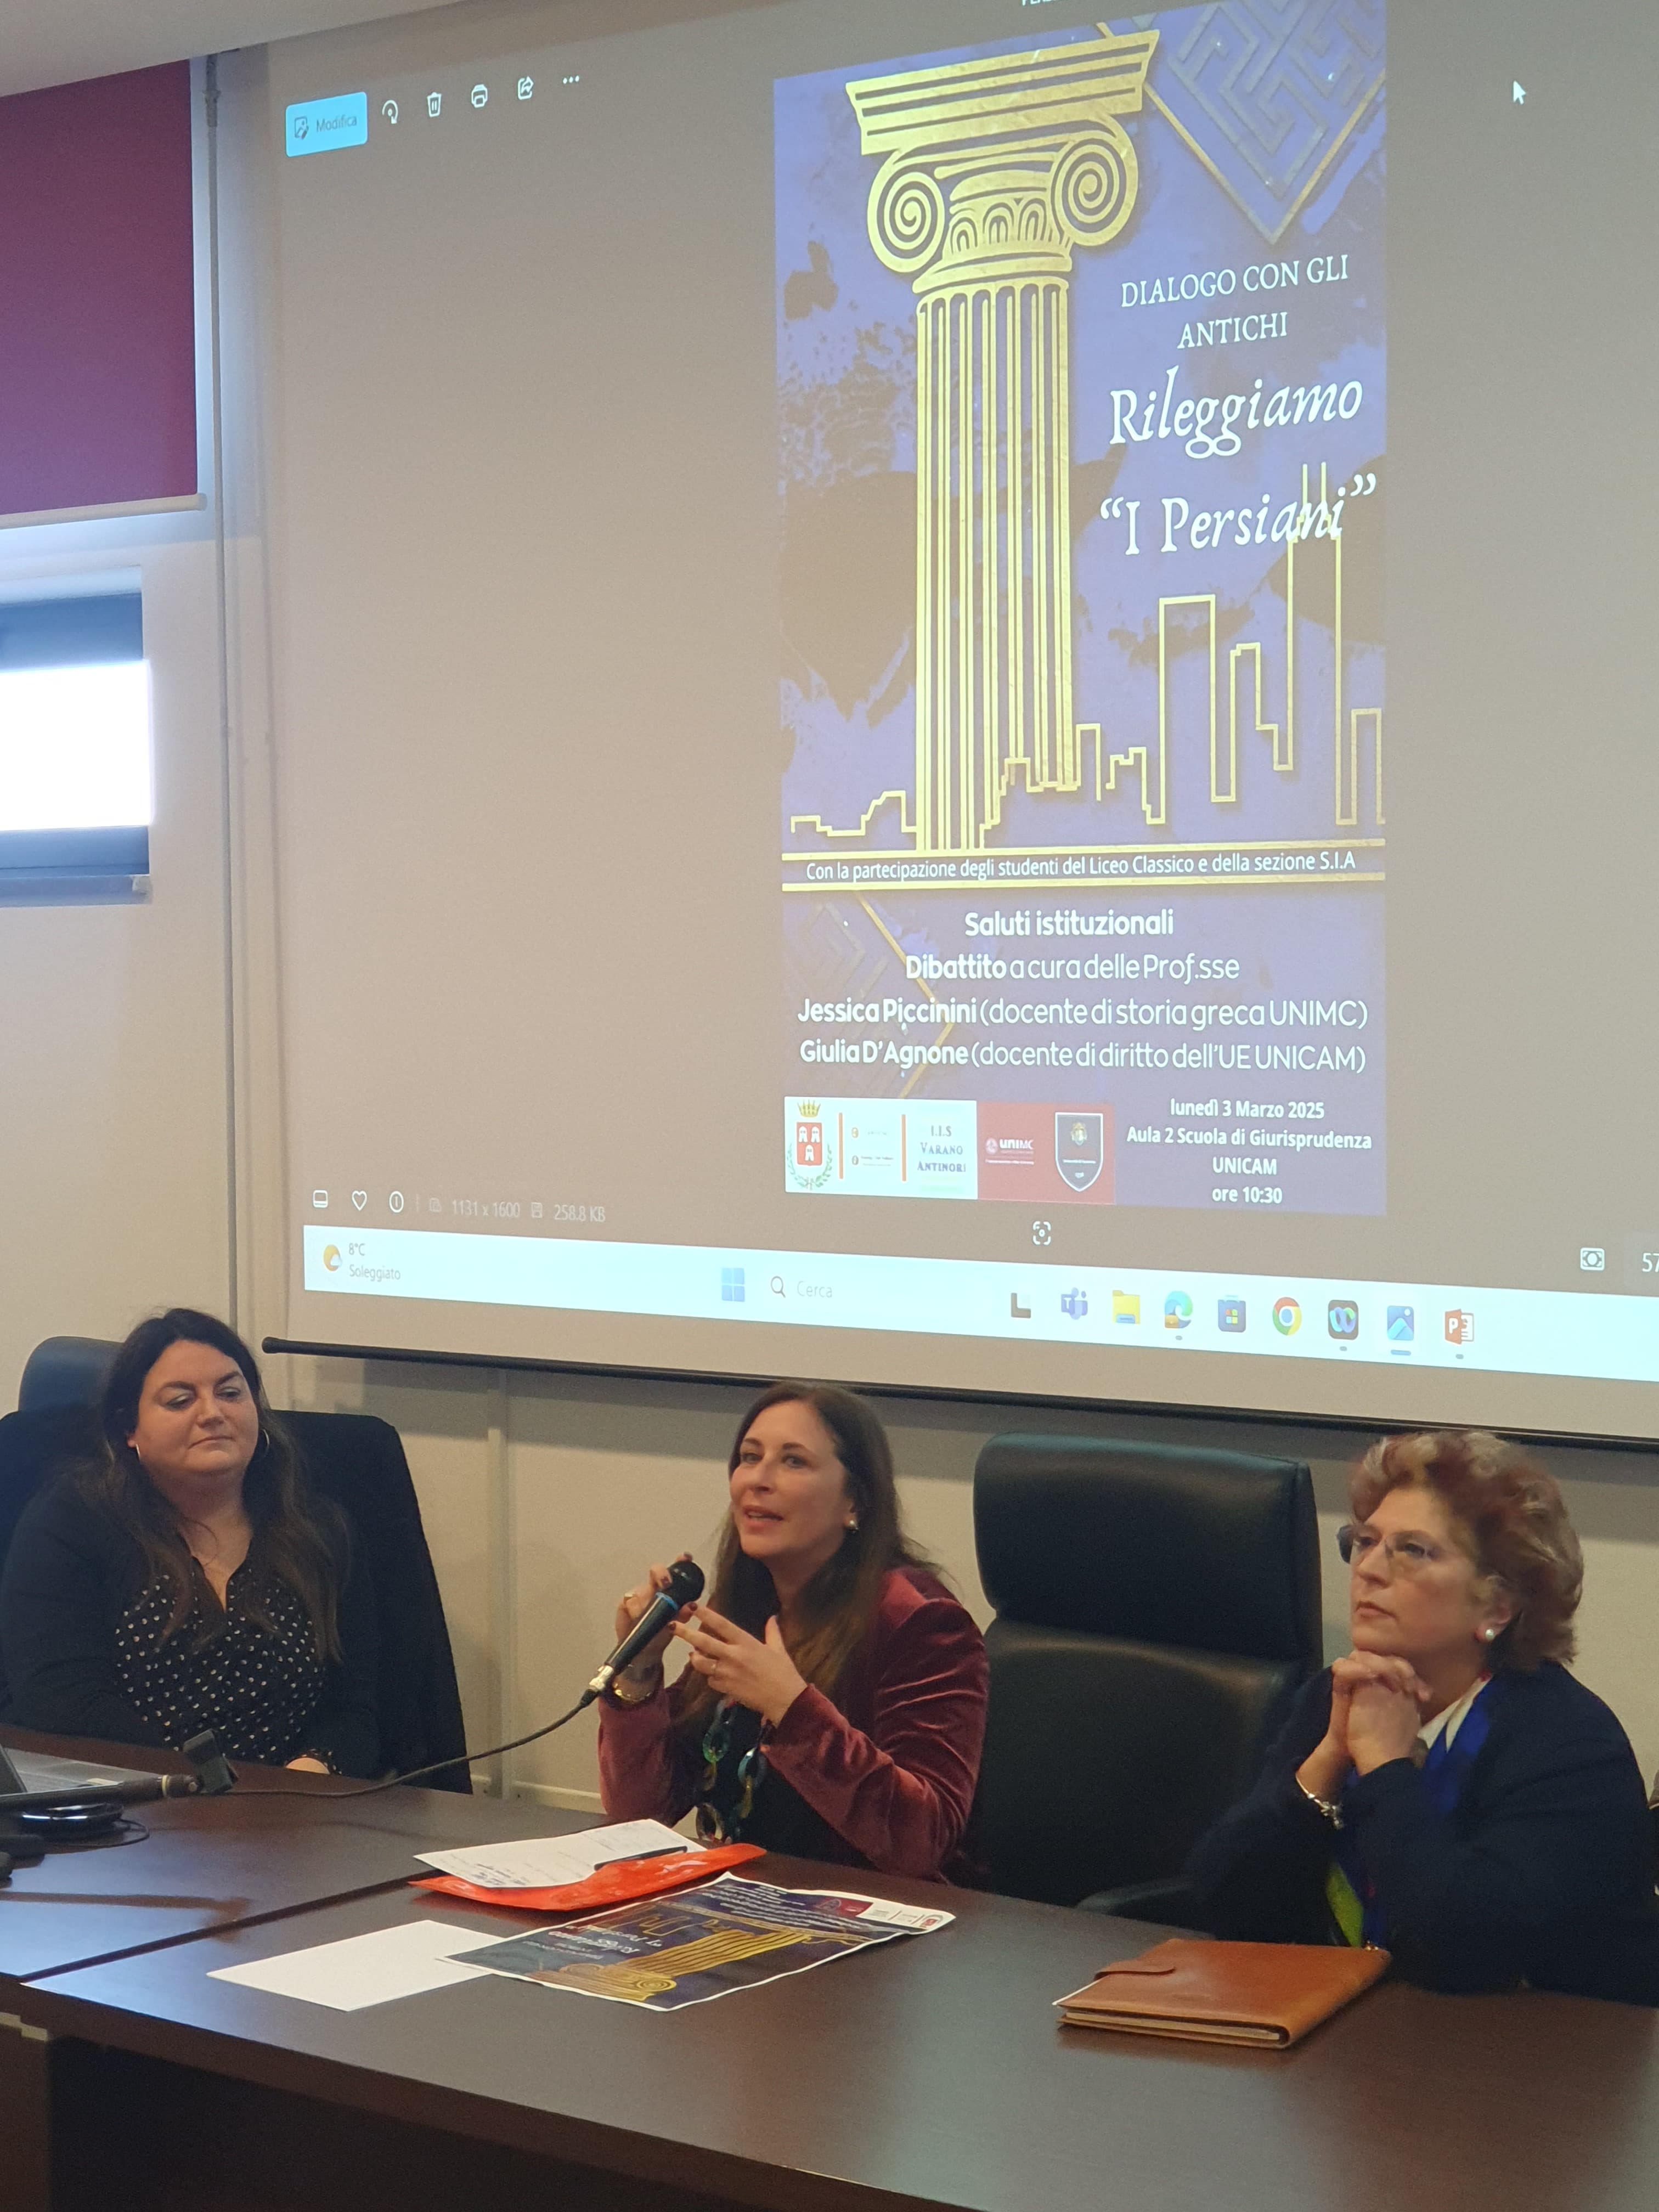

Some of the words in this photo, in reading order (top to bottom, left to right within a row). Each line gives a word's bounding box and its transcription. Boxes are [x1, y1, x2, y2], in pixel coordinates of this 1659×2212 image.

[317, 114, 357, 132] Modifica
[1121, 269, 1236, 307] DIALOGO
[1243, 261, 1300, 291] CON
[1307, 255, 1348, 283] GLI
[1177, 312, 1288, 349] ANTICHI
[1109, 365, 1363, 459] Rileggiamo
[1100, 497, 1140, 556] “I
[806, 863, 833, 880] Con
[837, 862, 849, 879] la
[853, 859, 956, 883] partecipazione
[960, 859, 995, 881] degli
[998, 857, 1058, 877] studenti
[1063, 856, 1085, 874] del
[1090, 856, 1128, 875] Liceo
[1132, 855, 1194, 873] Classico
[1198, 859, 1208, 872] e
[1212, 853, 1250, 872] della
[1254, 853, 1315, 871] sezione
[1319, 851, 1356, 870] S.I.A
[964, 911, 1031, 936] Saluti
[1036, 909, 1174, 936] istituzionali
[906, 953, 1007, 979] Dibattito
[1009, 959, 1024, 979] a
[1028, 958, 1081, 979] cura
[1084, 953, 1140, 979] delle
[1143, 953, 1240, 985] Prof.sse
[798, 997, 879, 1023] Jessica
[883, 997, 977, 1024] Piccinini
[980, 998, 1088, 1026] (docente
[1091, 998, 1113, 1025] di
[1116, 998, 1187, 1025] storia
[1191, 1005, 1265, 1031] greca
[1269, 1000, 1368, 1030] UNIMC)
[800, 1038, 860, 1064] Giulia
[971, 1041, 1073, 1068] (docente
[1075, 1042, 1096, 1068] di
[1099, 1042, 1169, 1068] diritto
[1255, 1045, 1366, 1074] UNICAM)
[1170, 1098, 1218, 1117] lunedì
[1222, 1100, 1232, 1117] 3
[1235, 1101, 1284, 1118] Marzo
[1288, 1102, 1324, 1119] 2025
[1126, 1126, 1161, 1143] Aula
[1164, 1127, 1174, 1143] 2
[1177, 1127, 1227, 1146] Scuola
[1231, 1128, 1245, 1145] di
[1250, 1130, 1372, 1152] Giurisprudenza
[1212, 1156, 1277, 1175] UNICAM
[1212, 1188, 1238, 1202] ore
[1243, 1186, 1282, 1204] 10:30
[483, 1206, 489, 1216] x
[494, 1201, 520, 1217] 1600
[555, 1204, 586, 1221] 258.8
[590, 1206, 606, 1222] KB
[348, 1243, 365, 1256] 8°C
[349, 1264, 401, 1282] Soleggiato
[797, 1281, 833, 1298] Cerca
